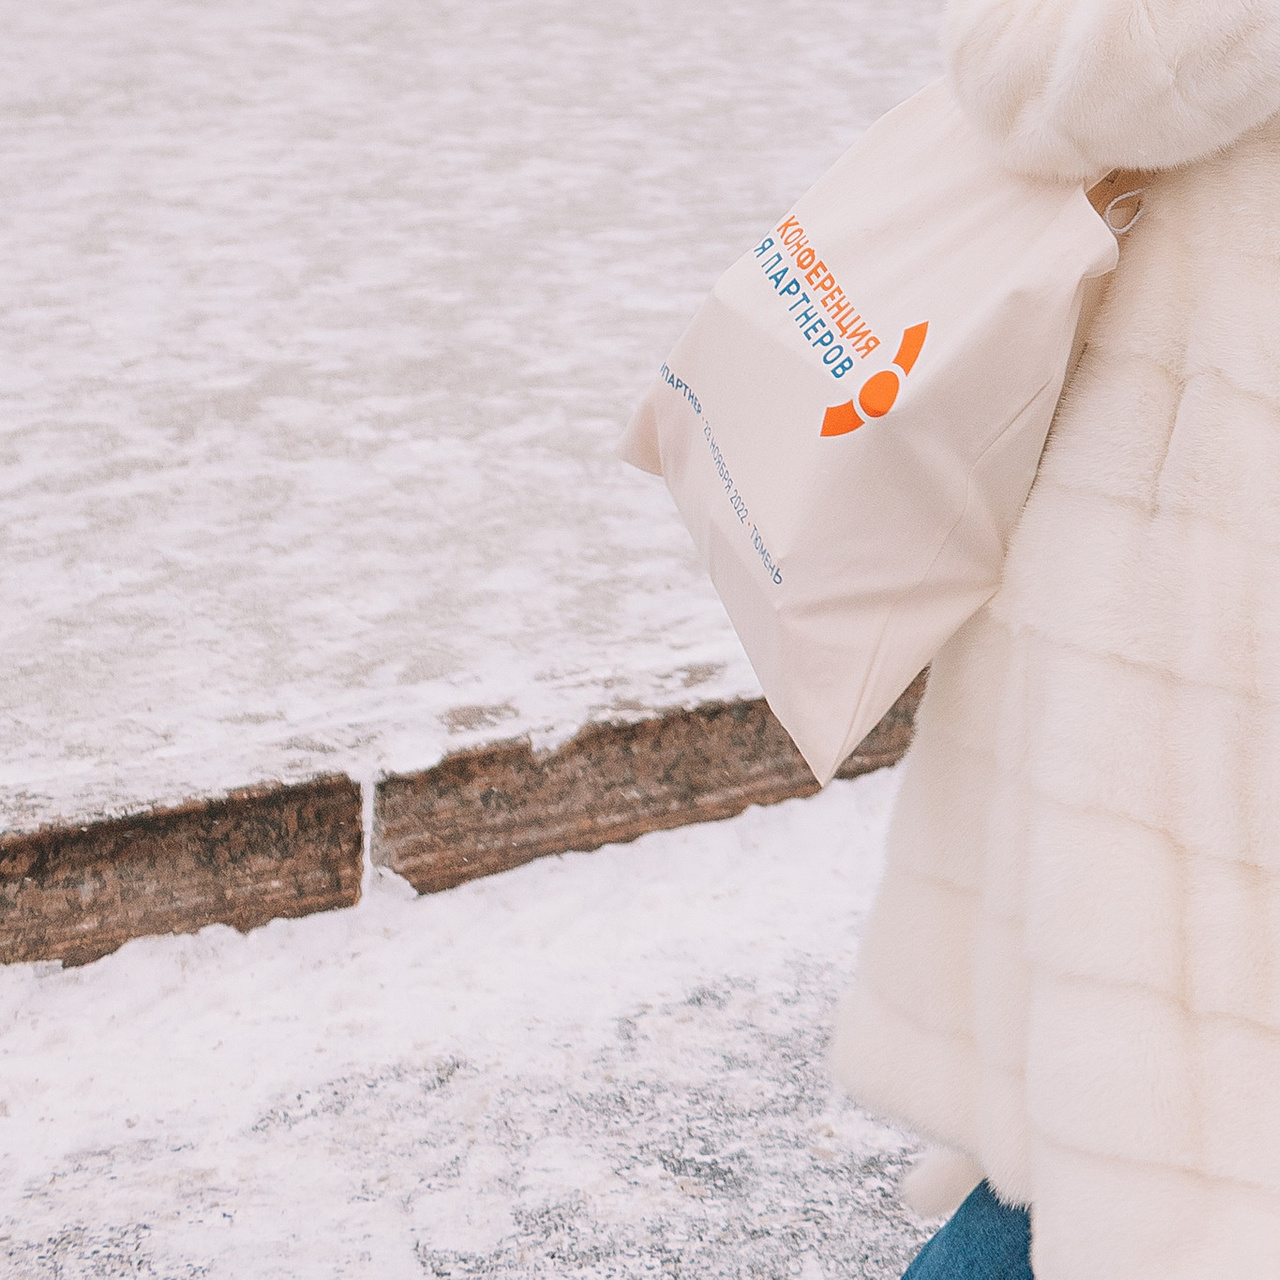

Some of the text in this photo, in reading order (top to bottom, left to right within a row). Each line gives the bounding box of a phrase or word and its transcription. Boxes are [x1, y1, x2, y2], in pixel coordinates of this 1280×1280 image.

[761, 252, 854, 379] ПАРТНЕРОВ
[776, 215, 881, 359] КОНФЕРЕНЦИЯ
[710, 436, 734, 494] НОЯБРЯ
[729, 489, 749, 524] 2022
[750, 524, 783, 585] ТЮМЕНЬ
